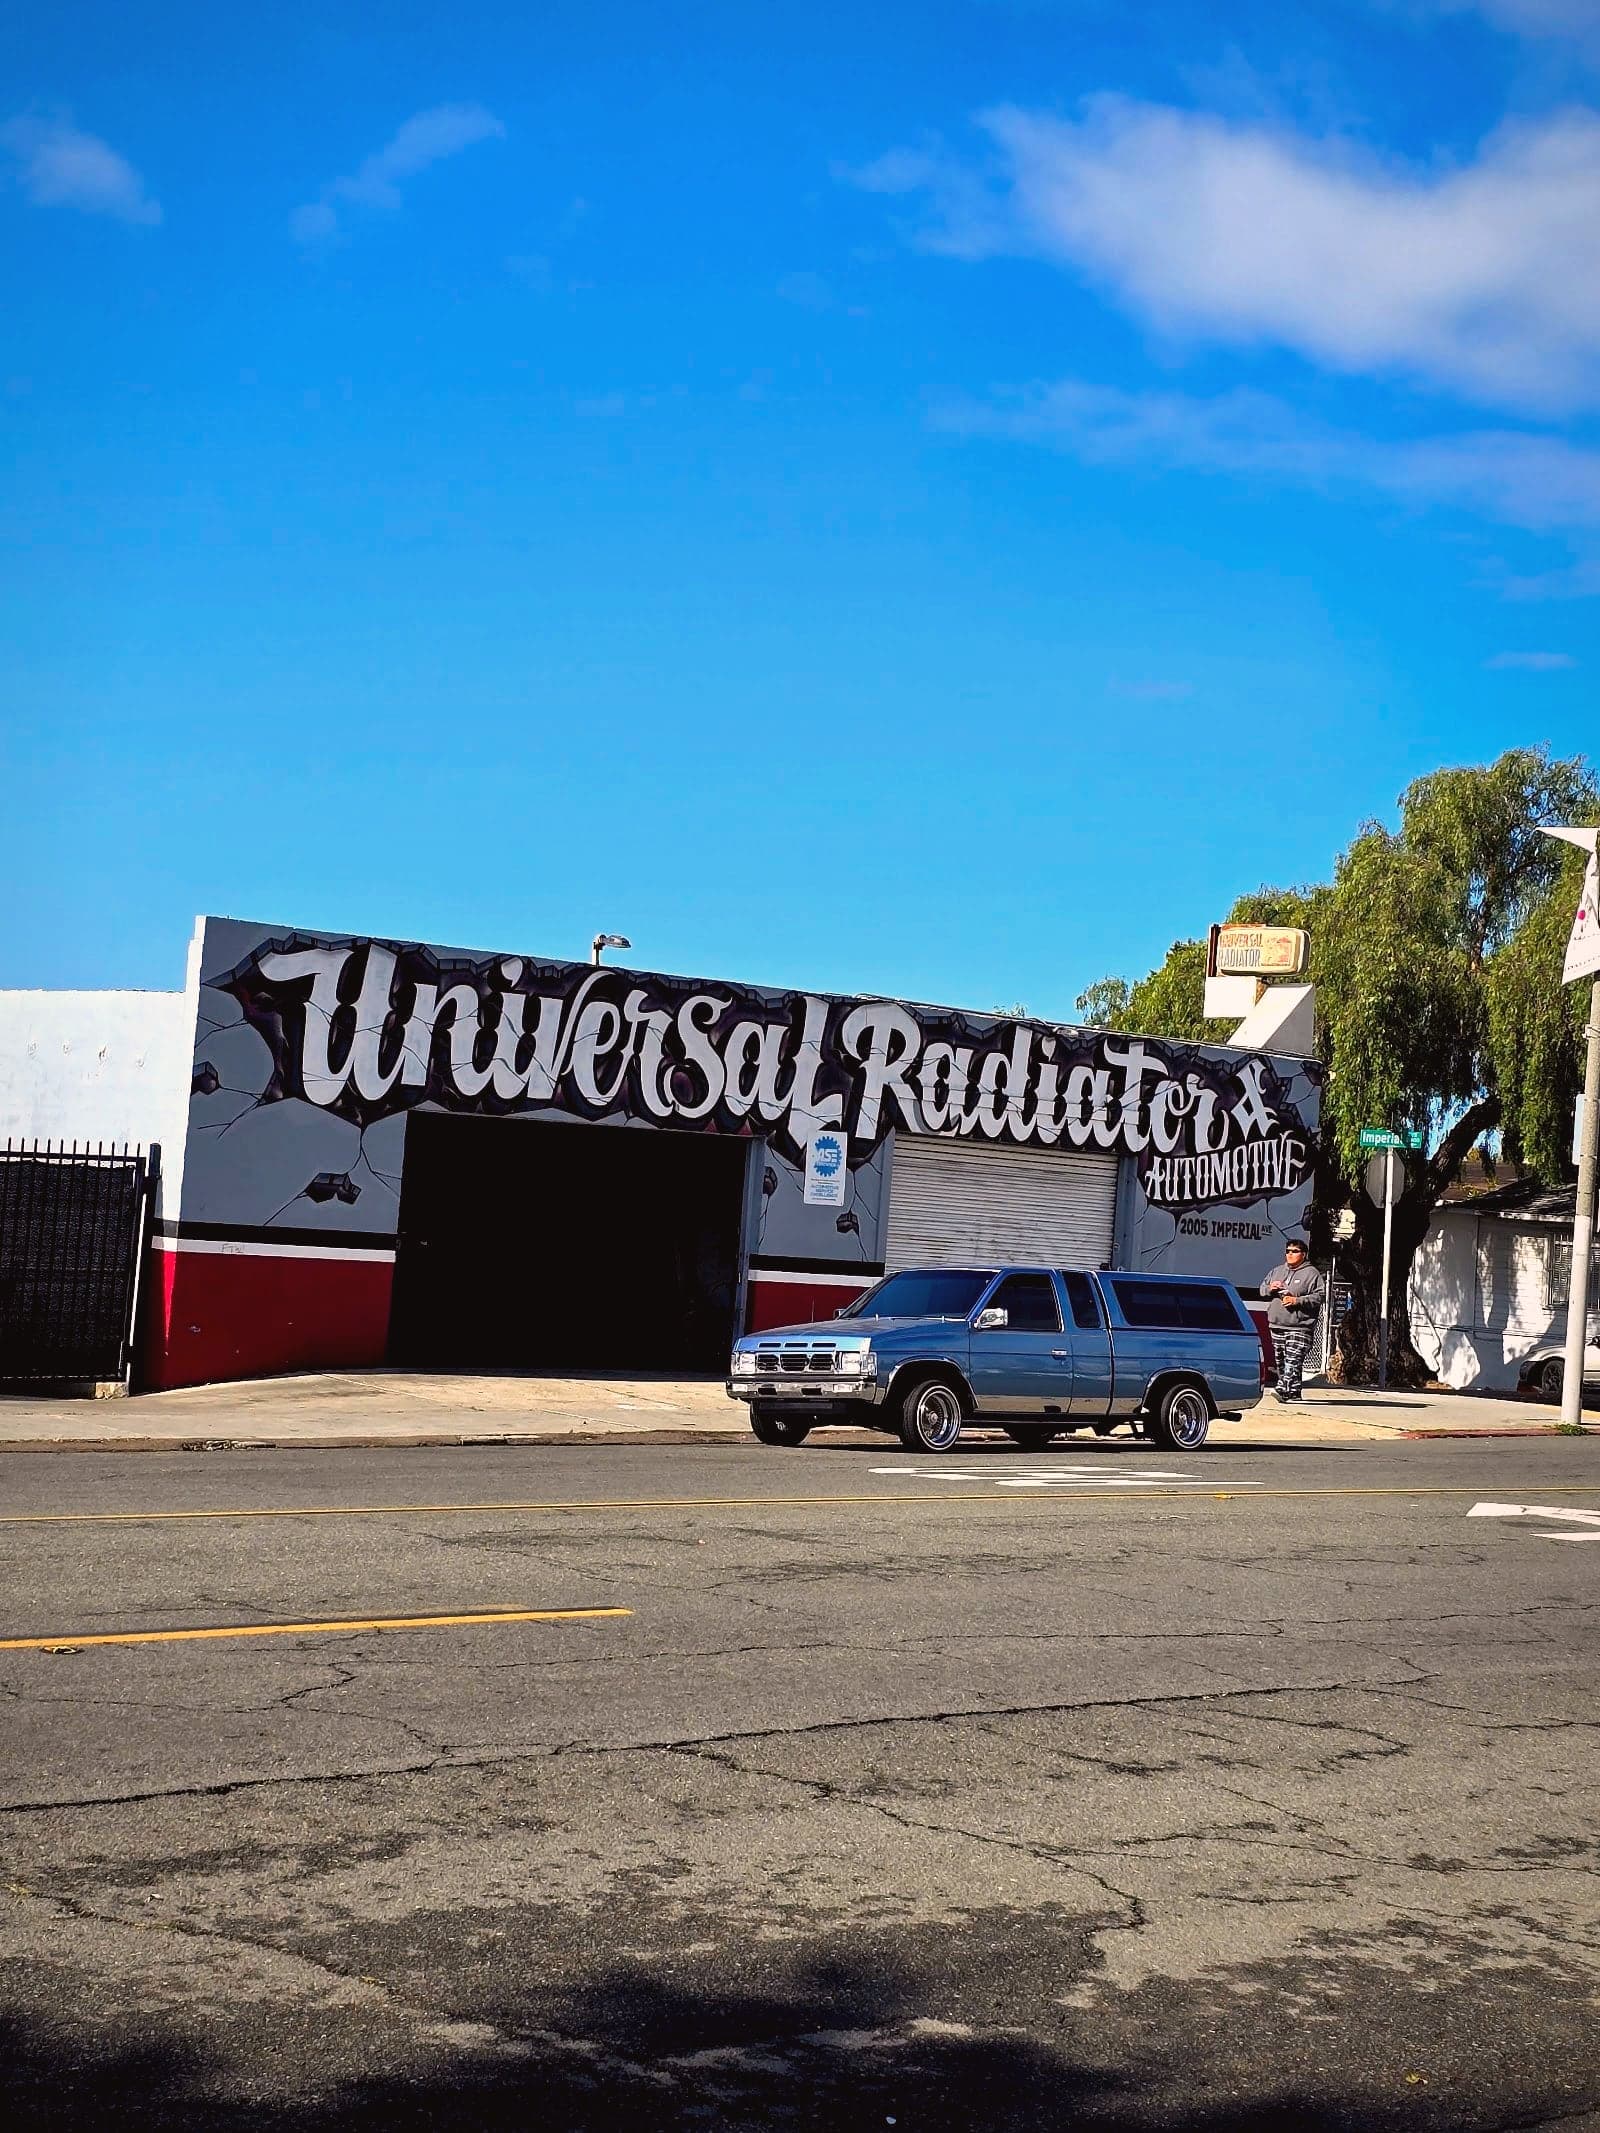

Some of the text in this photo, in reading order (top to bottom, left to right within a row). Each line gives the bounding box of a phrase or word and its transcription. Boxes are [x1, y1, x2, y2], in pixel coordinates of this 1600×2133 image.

[1217, 948, 1261, 967] RADIATOR
[842, 1003, 1229, 1153] Radiator
[817, 1148, 838, 1163] ASE
[1145, 1130, 1306, 1201] AUTOMOTIVE
[1180, 1218, 1273, 1241] 2005 IMPERIAL AVE
